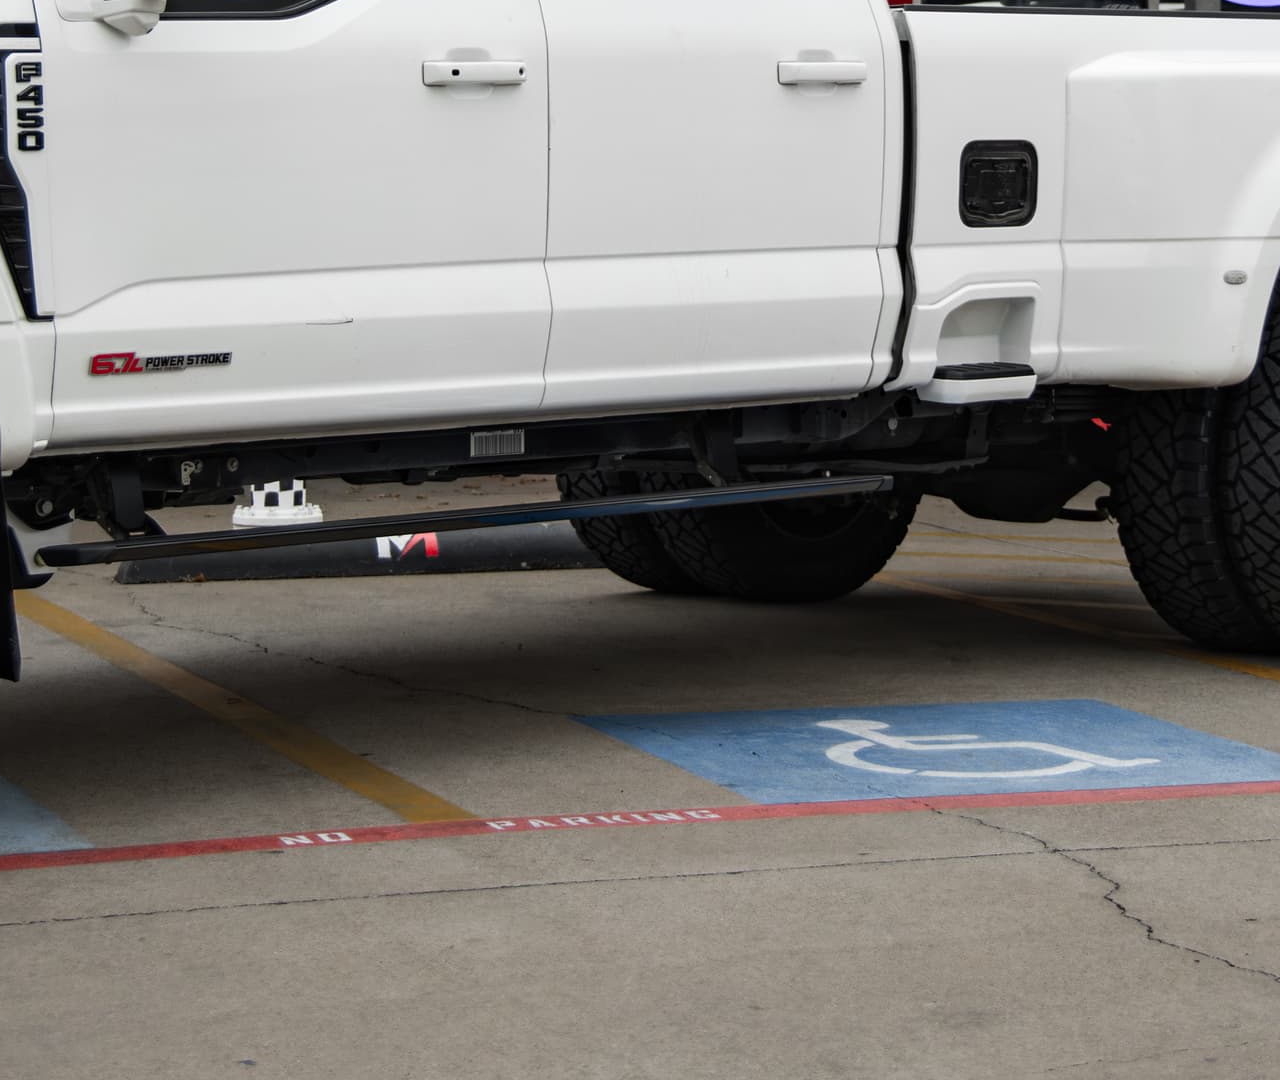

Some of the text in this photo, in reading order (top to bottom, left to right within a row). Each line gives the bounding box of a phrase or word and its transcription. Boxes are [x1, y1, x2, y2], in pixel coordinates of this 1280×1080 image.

[16, 62, 45, 152] F450
[91, 352, 144, 375] 6.7L
[145, 357, 185, 368] POWER
[186, 352, 231, 366] STROKE
[278, 808, 722, 846] NO PARKING
